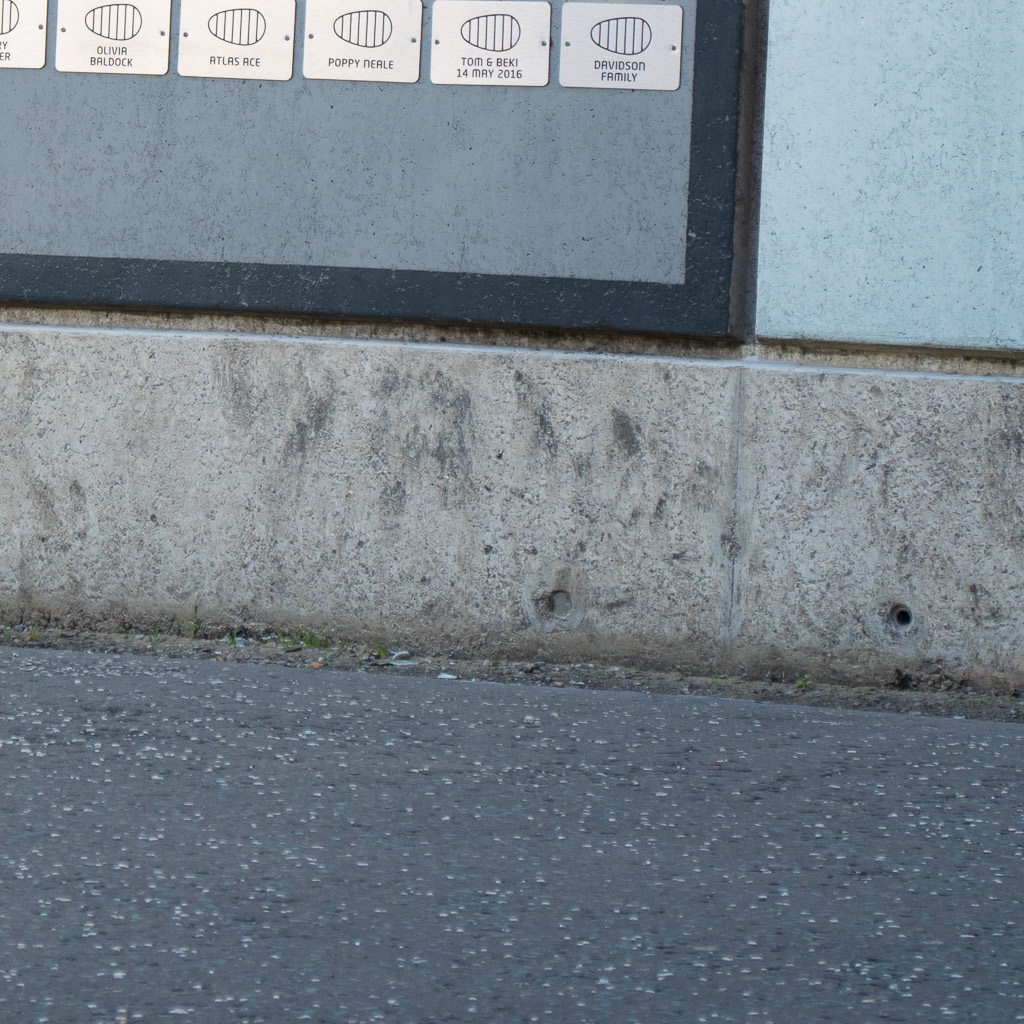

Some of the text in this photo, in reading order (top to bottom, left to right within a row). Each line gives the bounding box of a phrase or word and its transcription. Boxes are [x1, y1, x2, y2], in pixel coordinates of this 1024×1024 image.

[96, 45, 128, 56] OLIVIA
[89, 56, 133, 68] BALDOCK
[209, 55, 261, 68] ATLAS ACE
[328, 57, 395, 70] POPPY NEALE
[460, 56, 519, 68] TOM & BEKI
[594, 59, 646, 71] DAVIDSON
[456, 68, 523, 79] 14 MAY 2016
[600, 71, 638, 83] FAMILY
